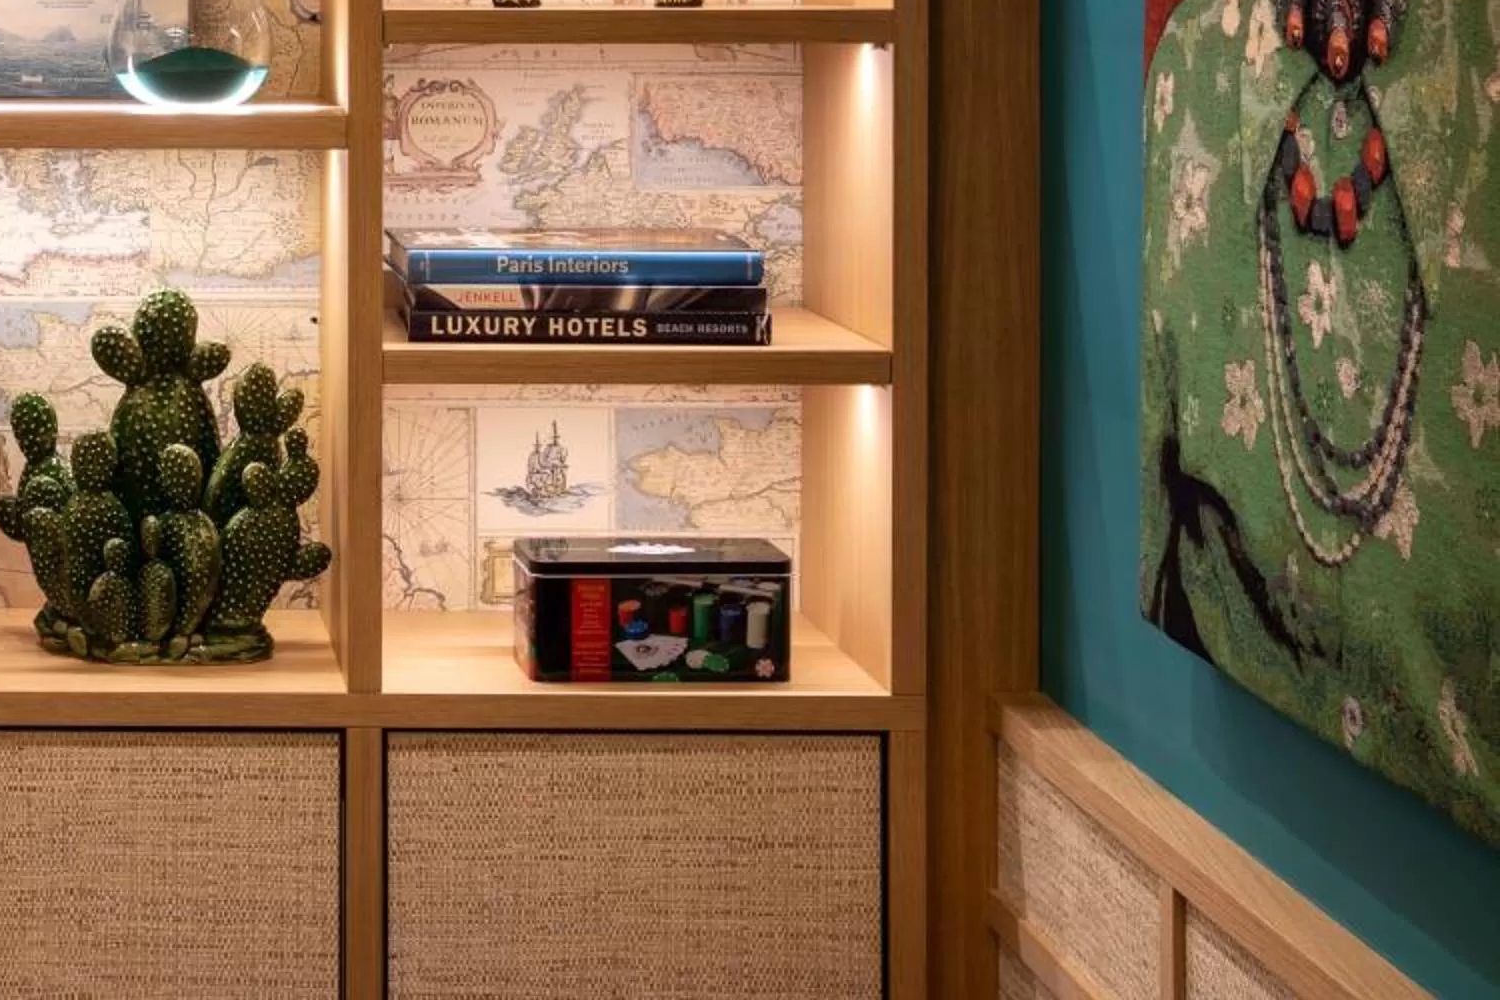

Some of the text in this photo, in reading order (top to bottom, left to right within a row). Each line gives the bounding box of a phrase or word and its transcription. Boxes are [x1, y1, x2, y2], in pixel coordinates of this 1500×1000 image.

[496, 255, 630, 275] Paris Interiors
[430, 315, 538, 336] LUXURY
[547, 316, 649, 338] HOTELS
